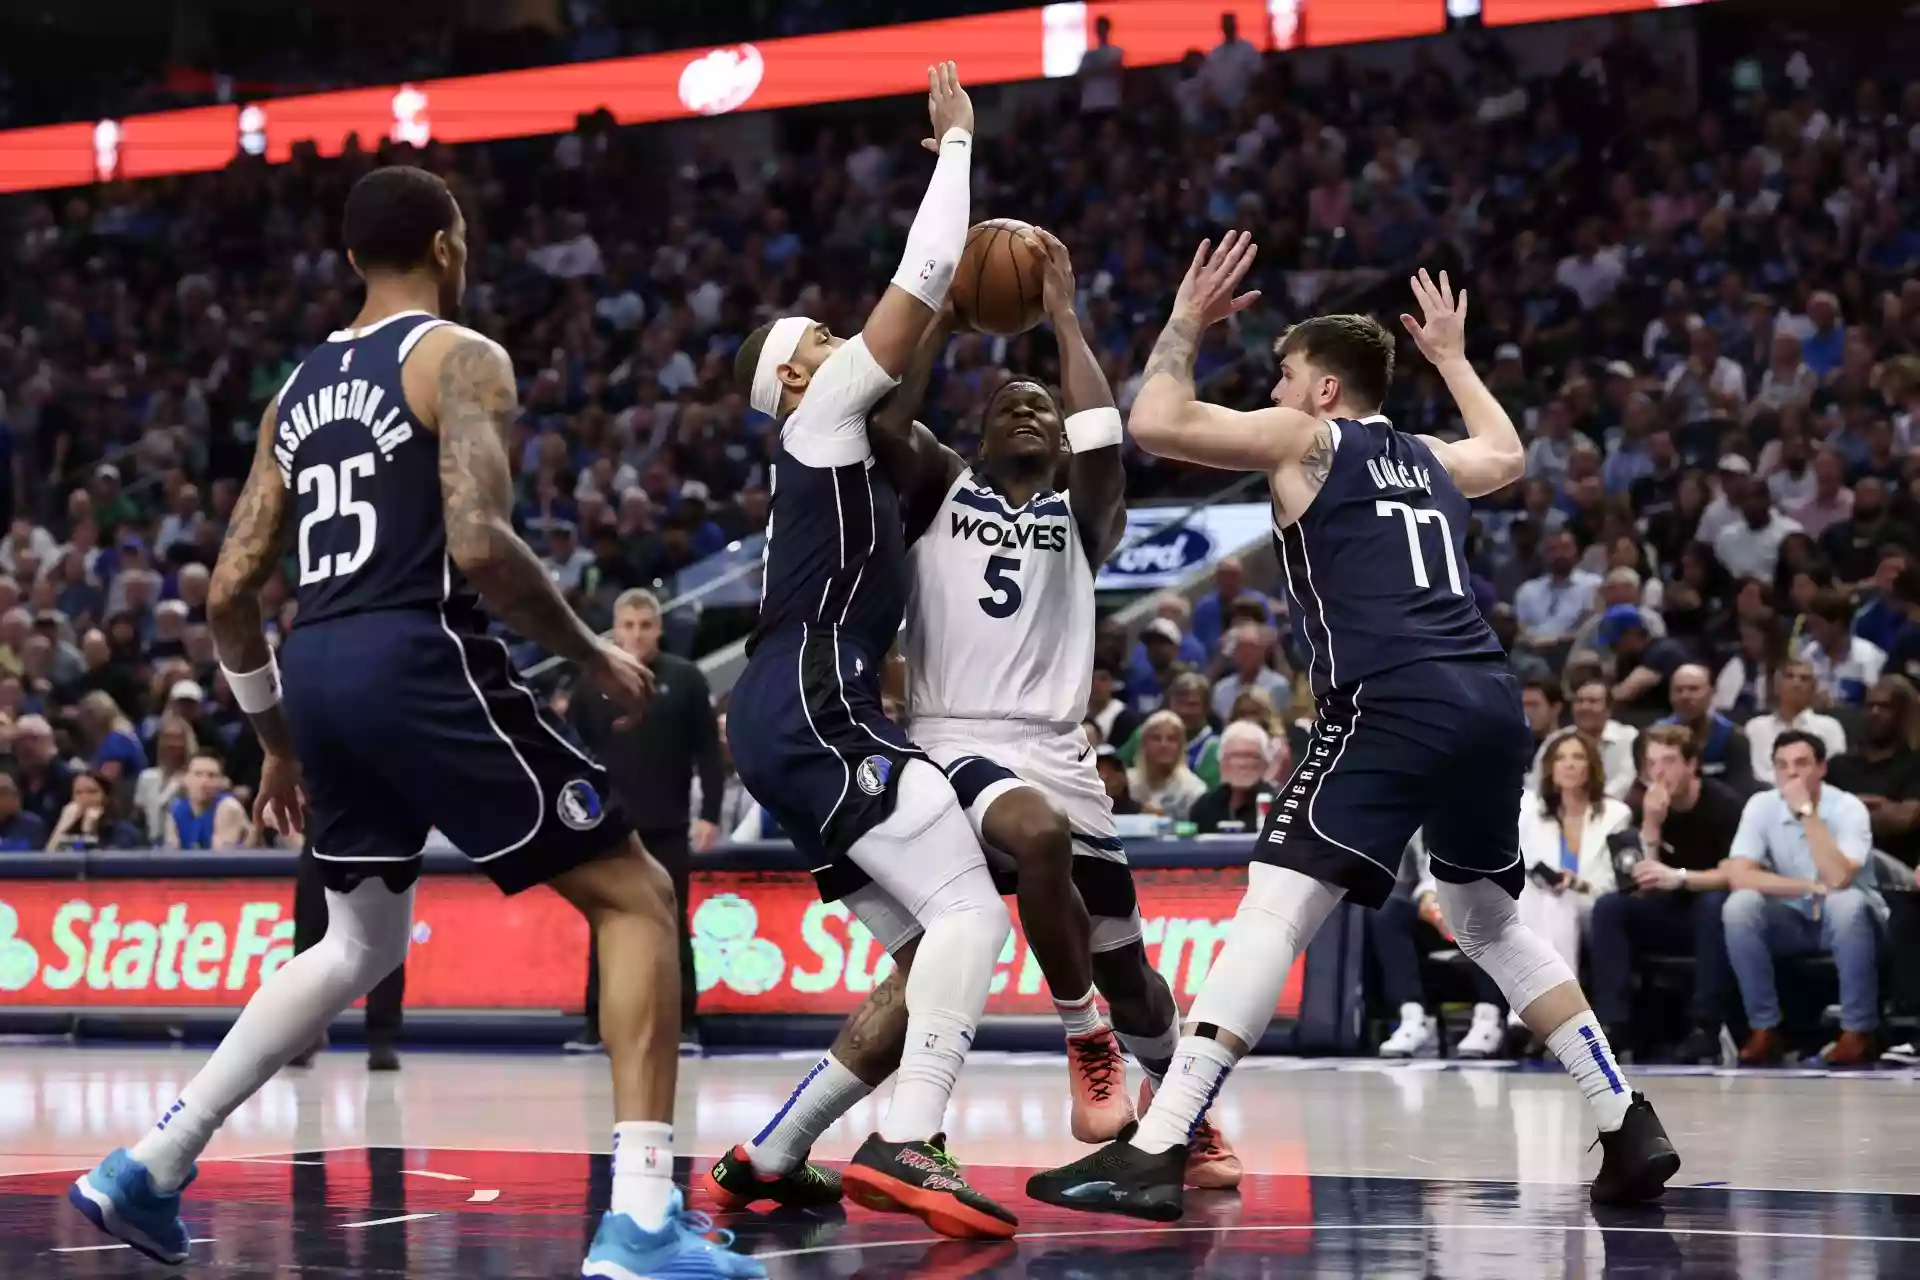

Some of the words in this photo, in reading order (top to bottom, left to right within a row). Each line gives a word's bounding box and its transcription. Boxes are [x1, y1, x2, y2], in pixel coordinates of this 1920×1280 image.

[372, 406, 413, 462] JR.
[297, 452, 377, 587] 25
[951, 511, 1067, 552] WOLVES
[1375, 500, 1465, 597] 77
[978, 554, 1022, 619] 5
[713, 1162, 728, 1182] 21
